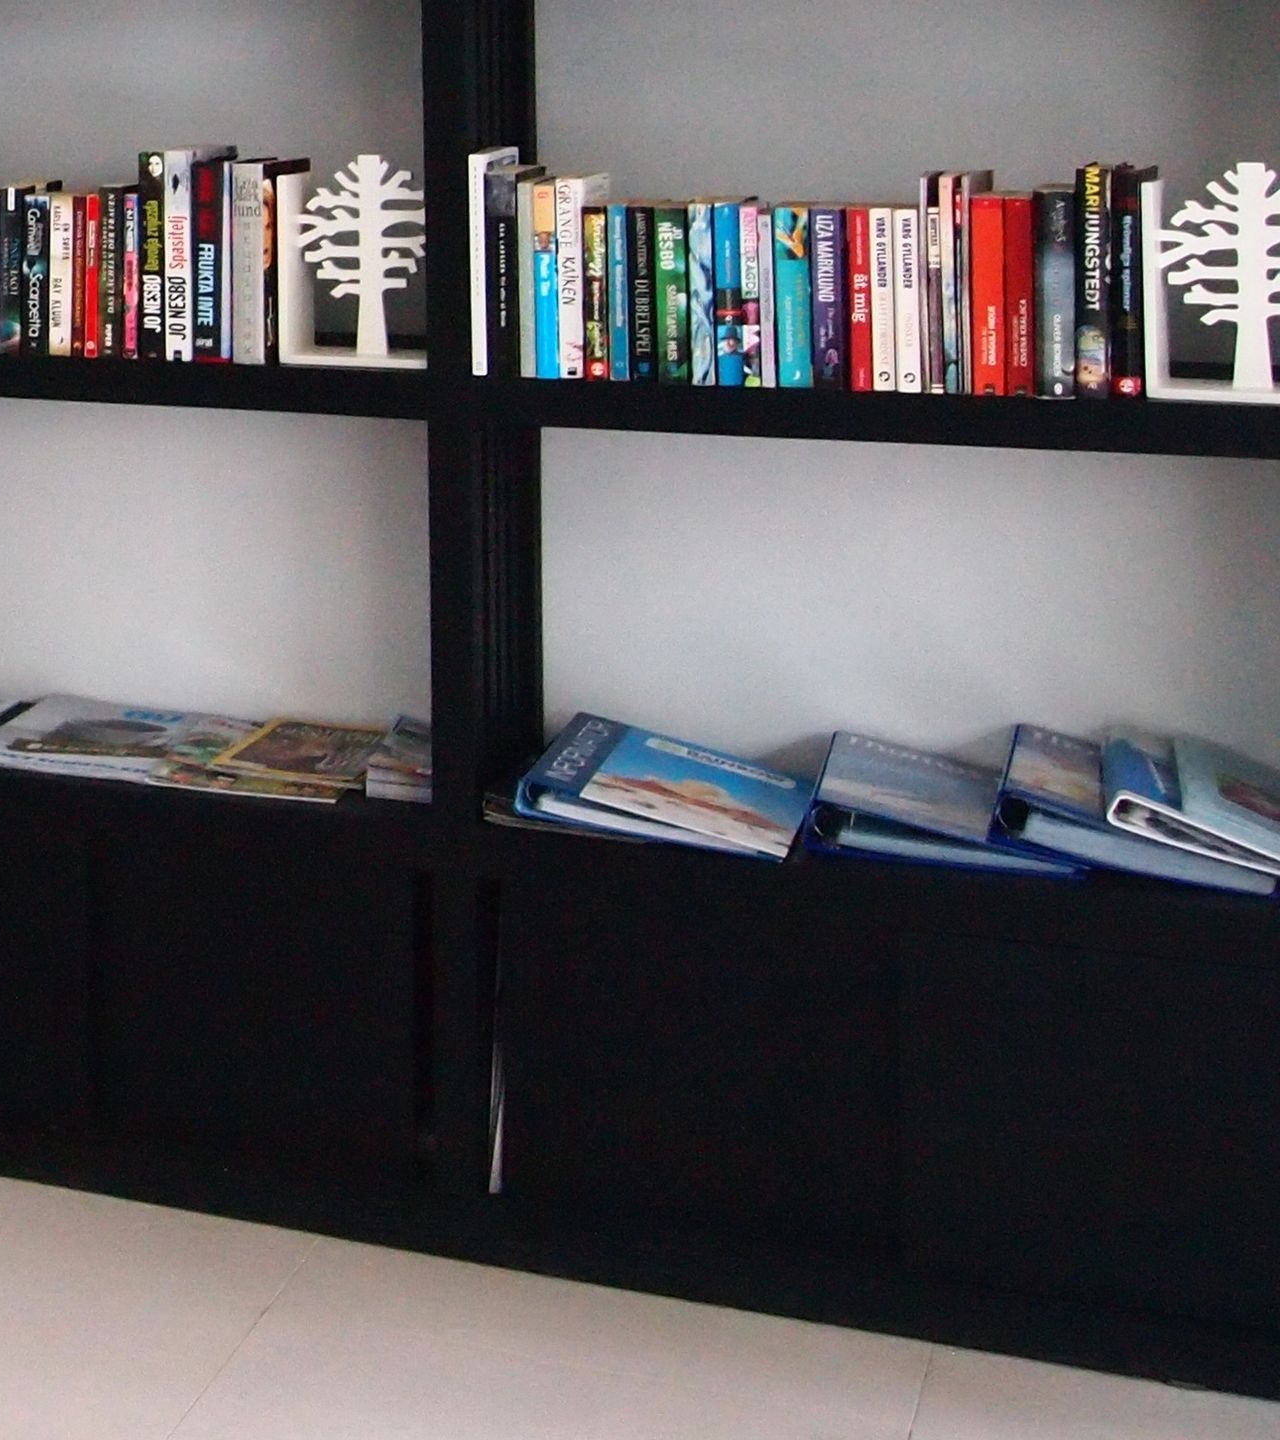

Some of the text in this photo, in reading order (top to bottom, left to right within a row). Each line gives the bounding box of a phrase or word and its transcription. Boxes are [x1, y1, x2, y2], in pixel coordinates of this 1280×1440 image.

[816, 215, 835, 302] LIZA MARKLUND
[875, 217, 888, 288] VARG GYLLANDER
[901, 218, 913, 289] VARG GYLLANDER
[1084, 164, 1100, 311] MARI JUNGSTEDT
[27, 273, 43, 338] Scarpetta
[143, 274, 162, 314] NESBØ
[167, 215, 188, 341] JO NESBØ Spasitelj
[197, 243, 215, 326] FRUKTA INTE
[851, 293, 868, 323] mig
[144, 315, 162, 333] JO
[634, 278, 651, 356] DUBBELSPEL
